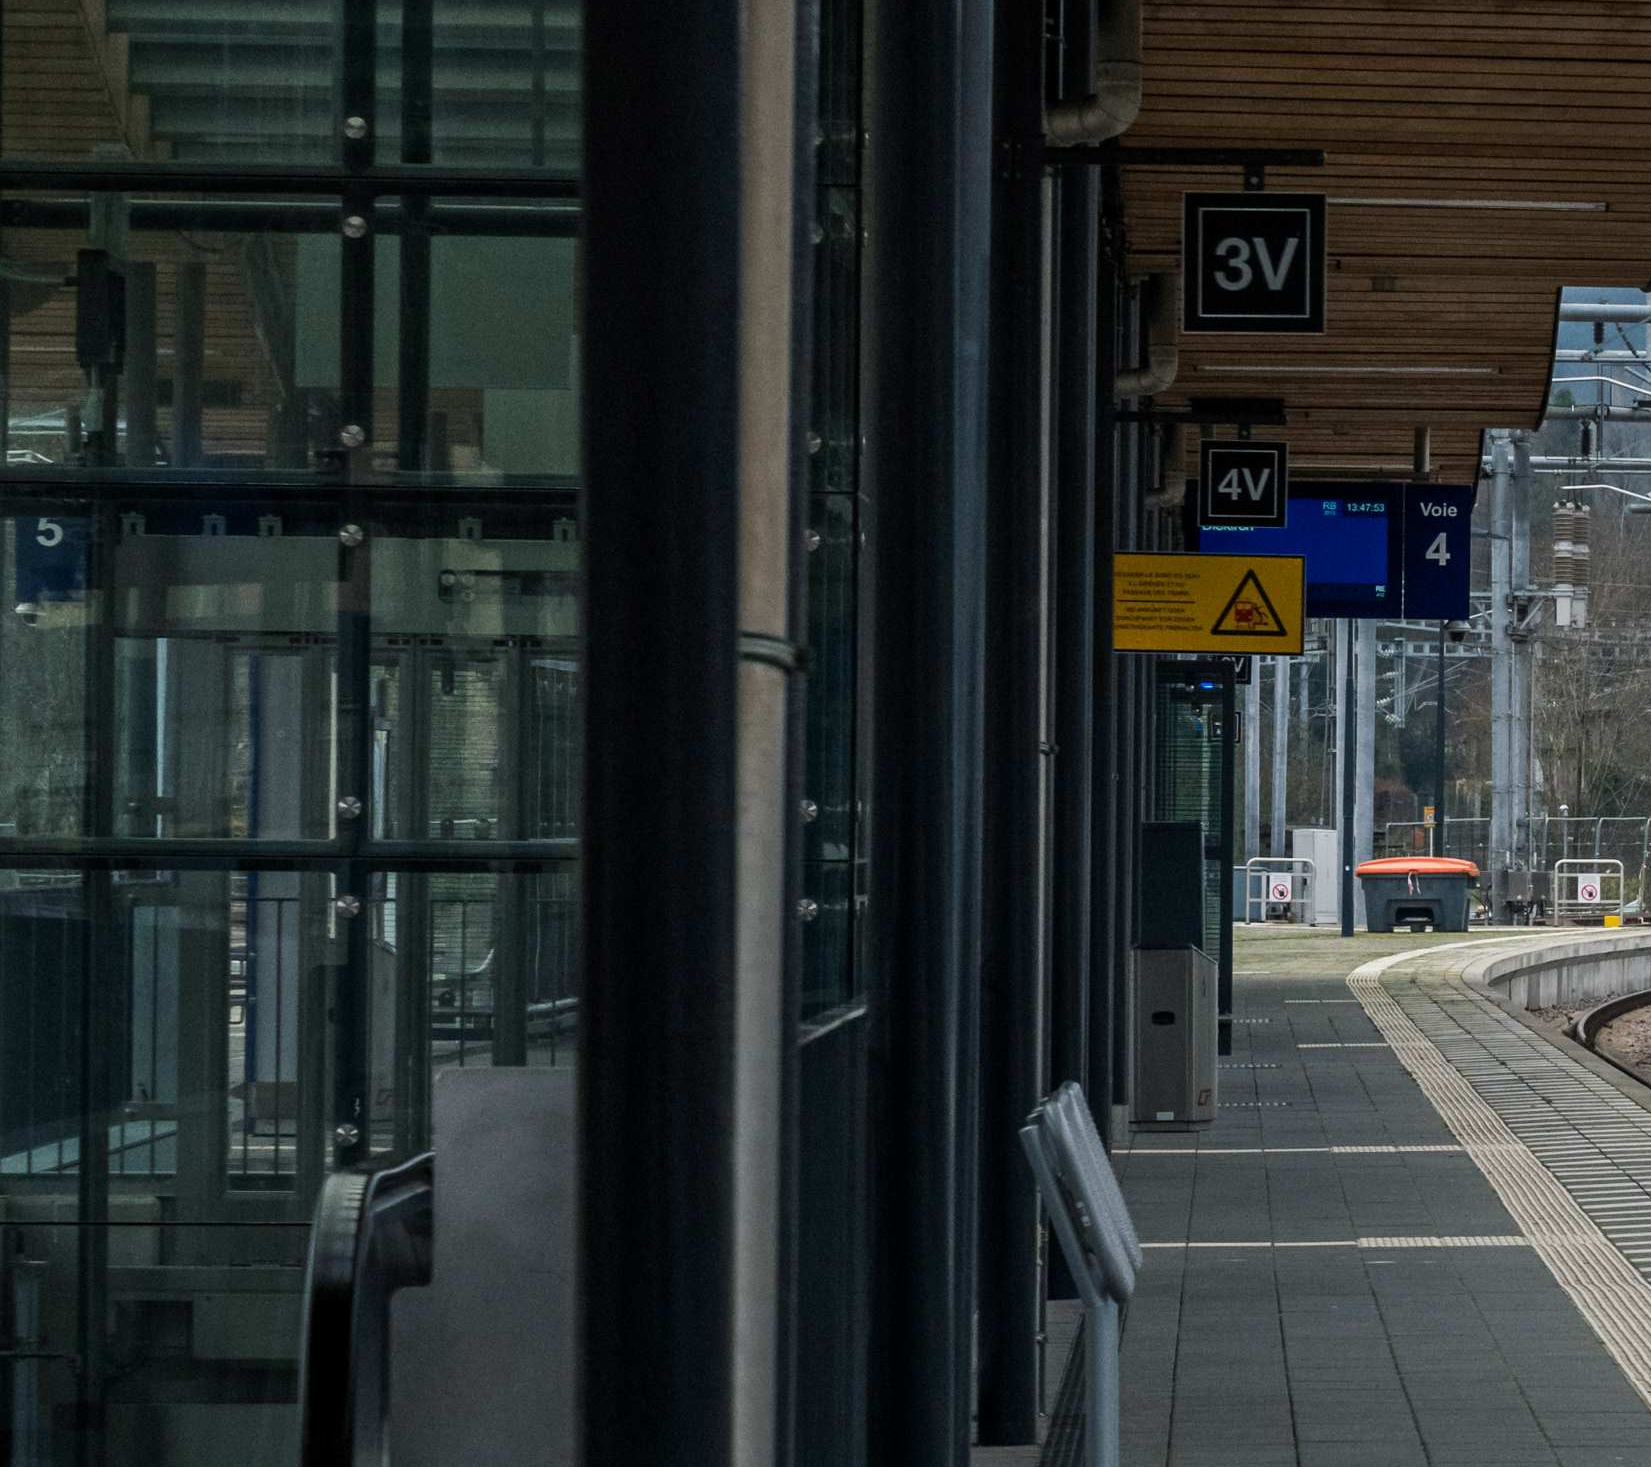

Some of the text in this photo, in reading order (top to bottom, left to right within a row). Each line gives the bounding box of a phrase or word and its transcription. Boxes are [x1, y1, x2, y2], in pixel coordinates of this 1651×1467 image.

[1213, 236, 1299, 292] 3V
[1217, 467, 1271, 502] 4V
[1346, 502, 1386, 513] 13:47:53
[1420, 502, 1458, 517] Voie
[36, 517, 63, 547] 5
[1425, 532, 1451, 566] 4
[1222, 656, 1245, 673] V
